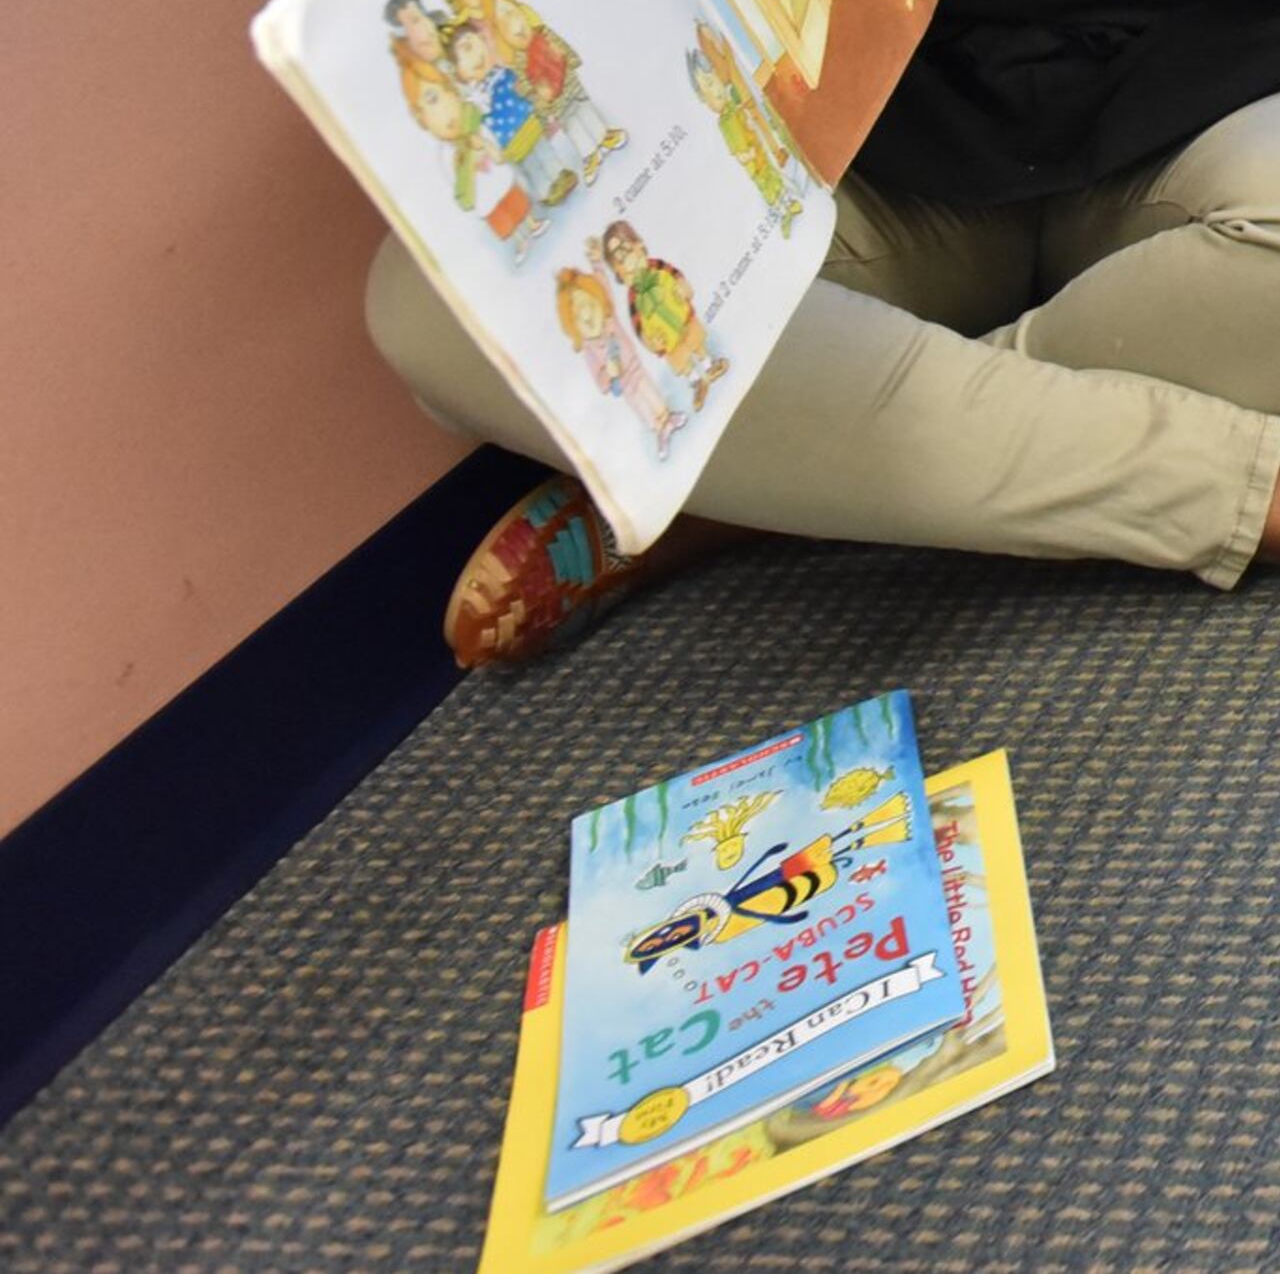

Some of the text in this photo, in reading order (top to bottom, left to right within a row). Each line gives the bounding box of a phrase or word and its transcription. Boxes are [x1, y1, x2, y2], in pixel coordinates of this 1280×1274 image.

[612, 195, 627, 214] 2
[693, 892, 875, 1005] SCUBA-CAT
[607, 916, 910, 1085] Pete the Cat
[806, 992, 871, 1029] Can
[705, 1029, 800, 1093] Read!
